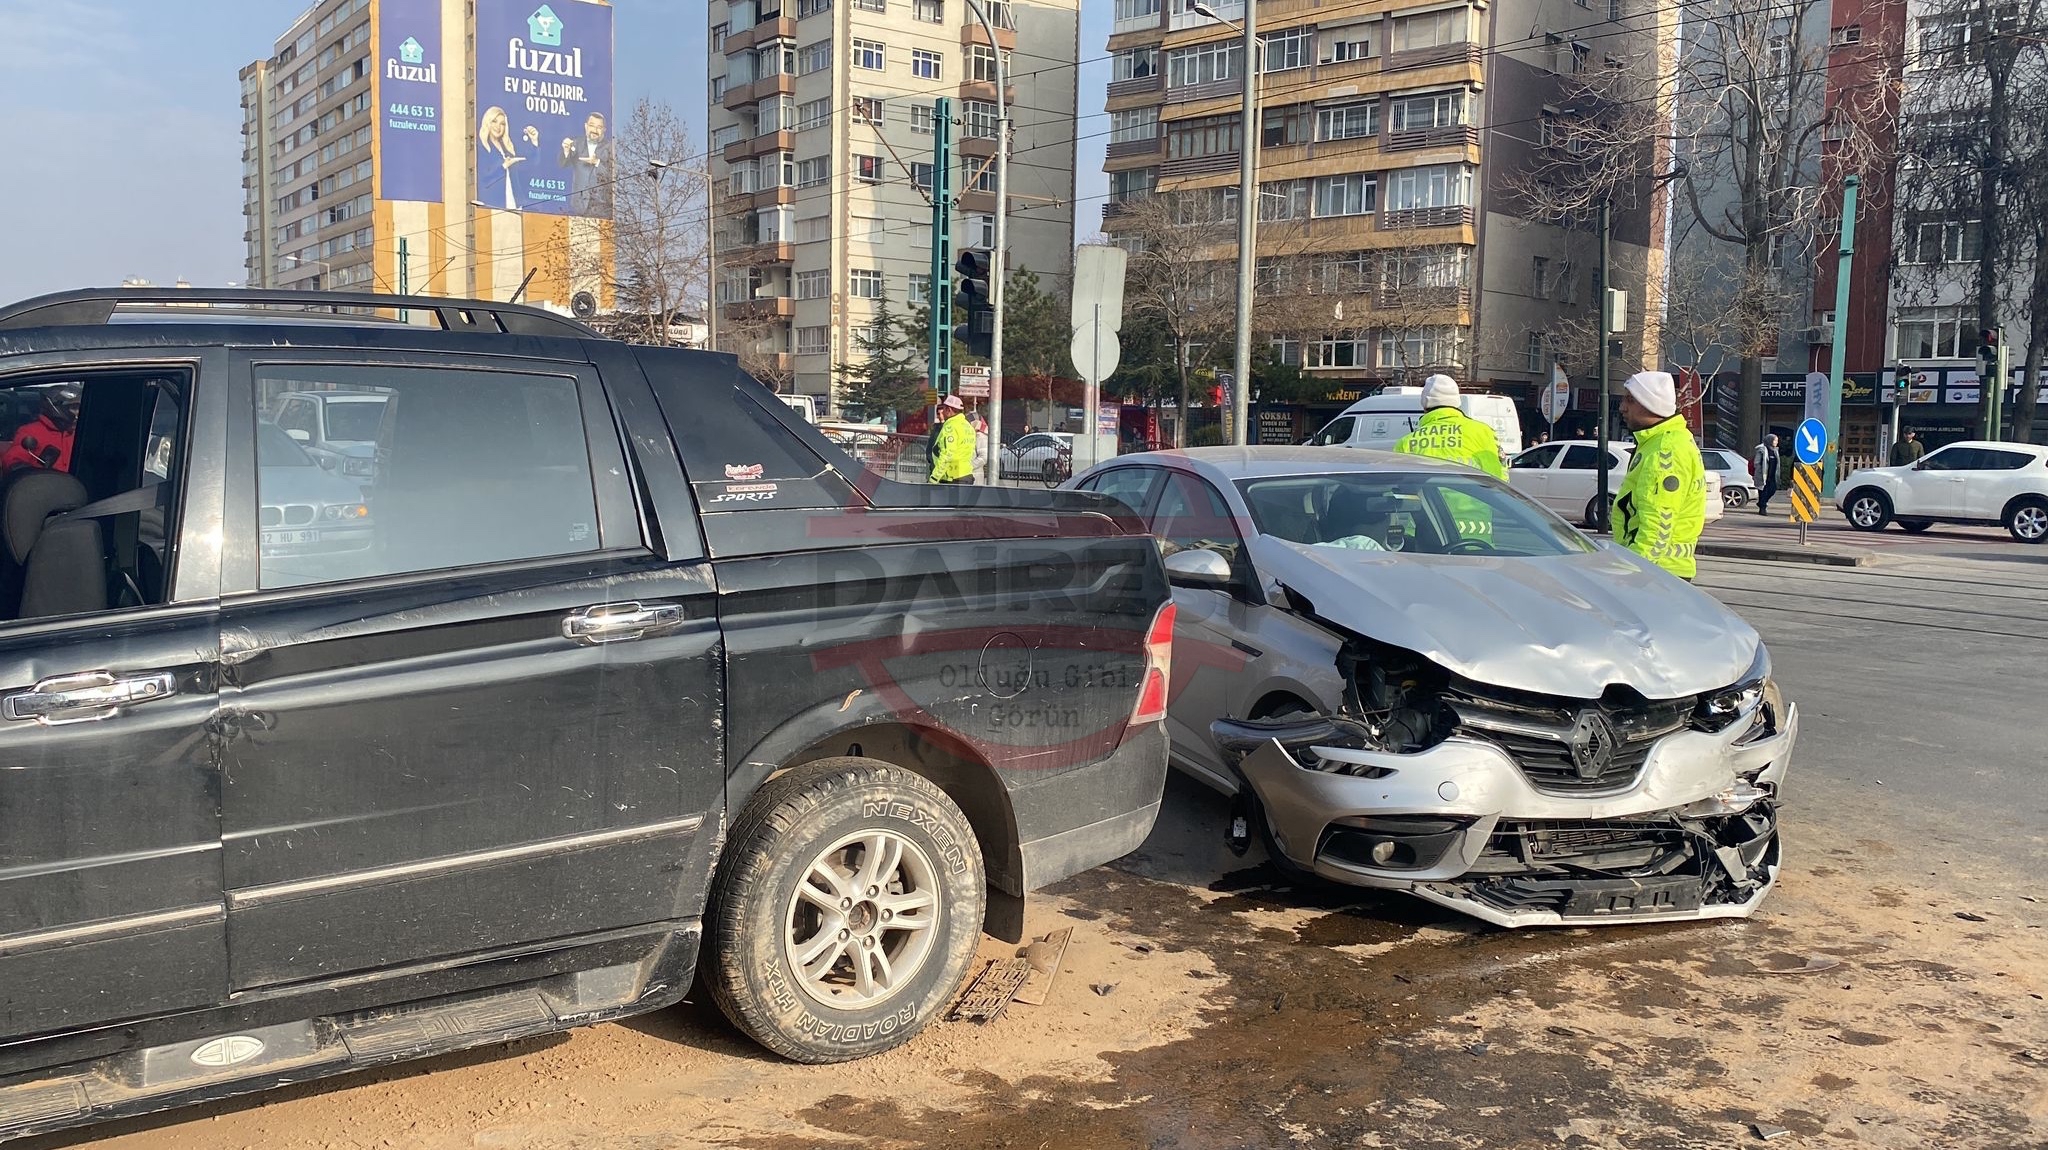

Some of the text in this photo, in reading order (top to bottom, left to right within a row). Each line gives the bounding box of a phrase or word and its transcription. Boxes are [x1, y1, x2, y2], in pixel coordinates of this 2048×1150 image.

[507, 37, 583, 78] fuzul
[386, 58, 437, 84] fuzul
[504, 76, 588, 102] EV DE ALDIRIR.
[389, 103, 435, 118] 444 63 13
[526, 96, 570, 116] OTO DA.
[389, 119, 436, 132] fuzulev.com
[529, 178, 566, 190] 444 63 13
[1412, 424, 1462, 438] TRAFİK
[1409, 436, 1462, 452] POLİSİ
[709, 491, 778, 503] SPORTS
[863, 800, 966, 875] NEXEN
[765, 958, 916, 1043] ROADIAN HTX
